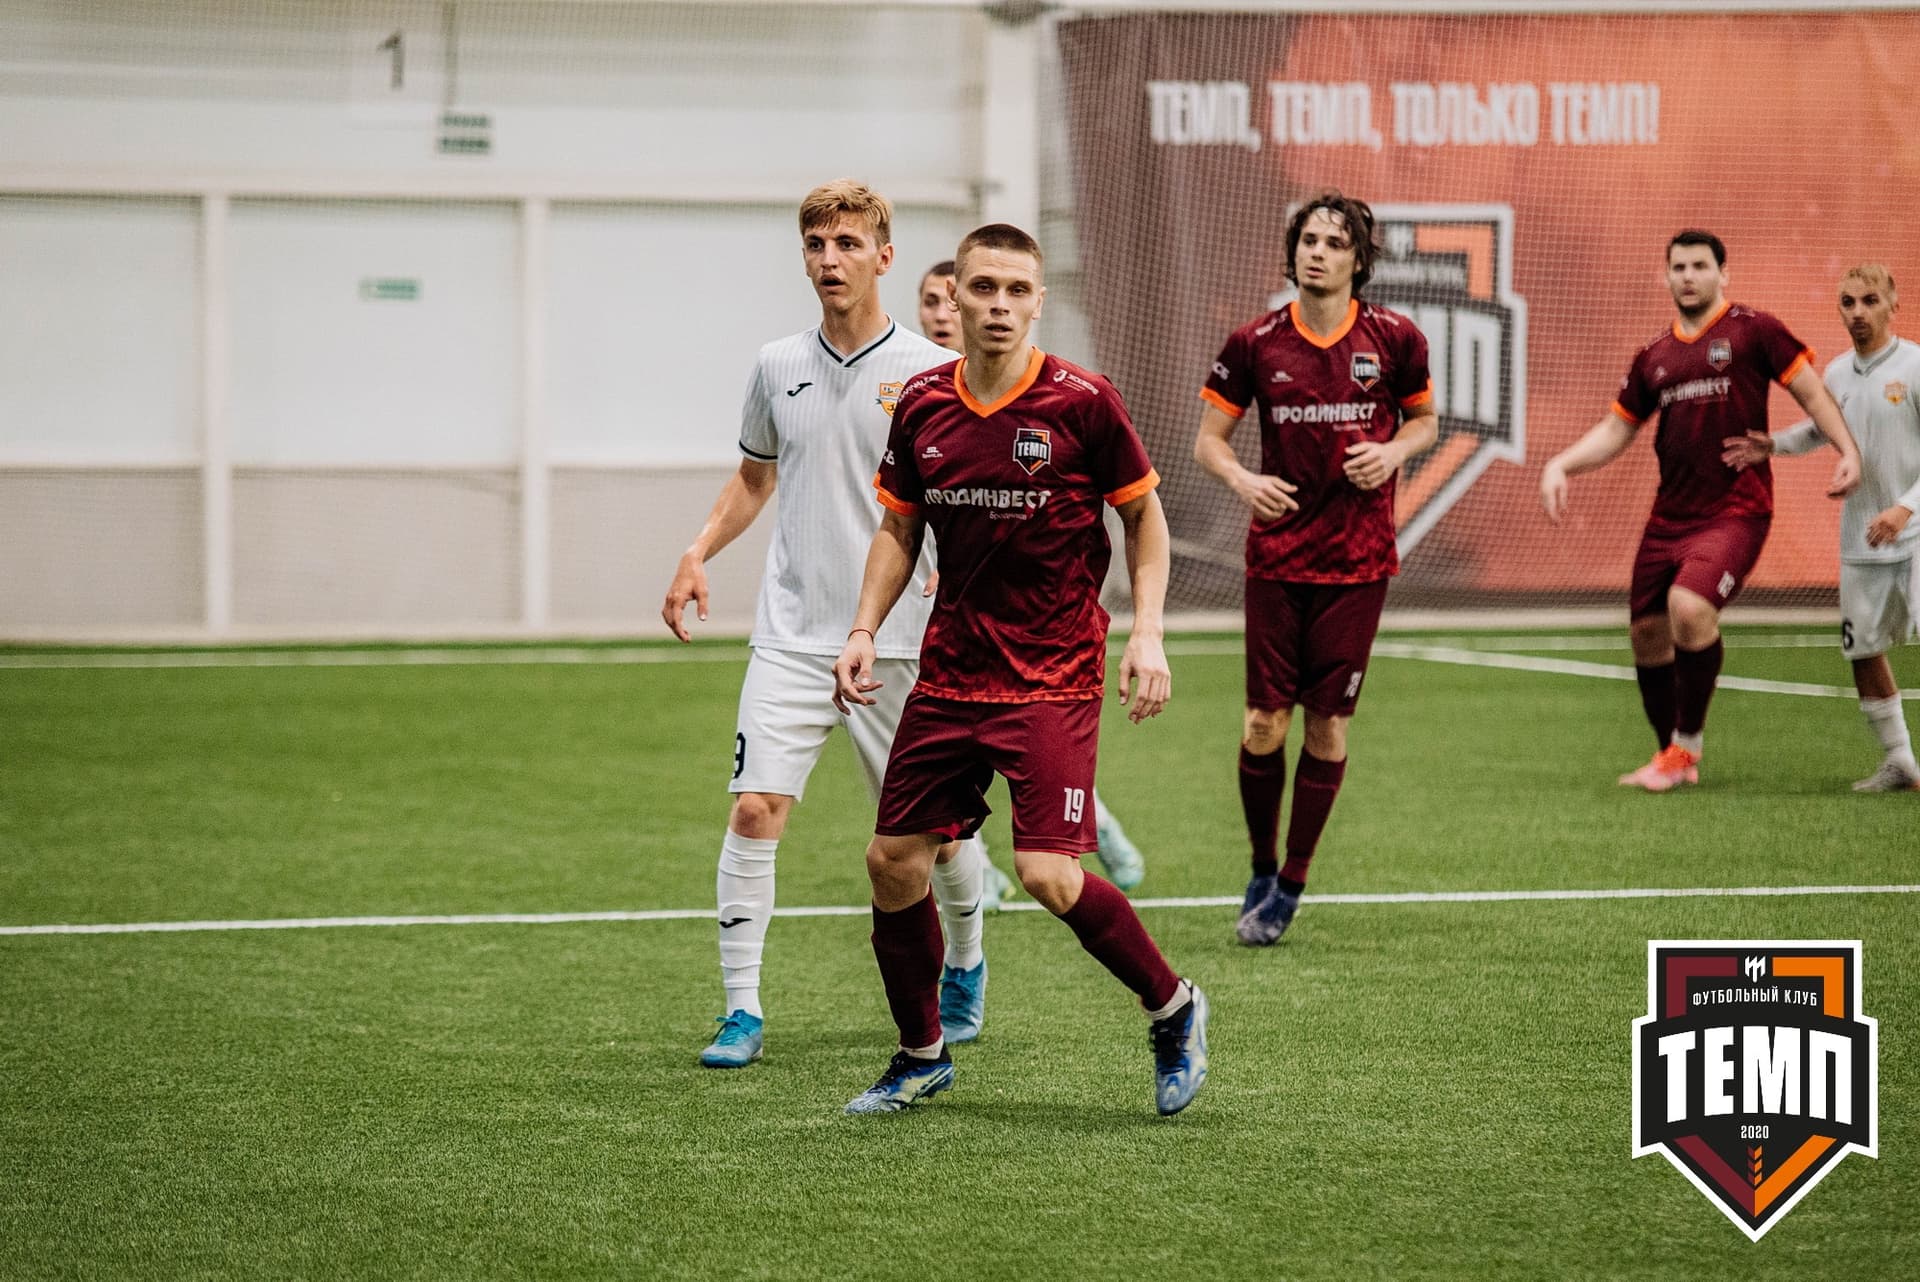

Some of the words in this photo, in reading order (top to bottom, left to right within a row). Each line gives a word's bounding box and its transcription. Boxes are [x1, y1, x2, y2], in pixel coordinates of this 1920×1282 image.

[376, 32, 403, 89] 1
[1148, 81, 1262, 152] ТЕМП,
[1268, 81, 1383, 152] ТЕМП,
[1390, 82, 1539, 146] ТОЛЬКО
[1548, 82, 1660, 144] ТЕМП!
[1017, 441, 1048, 460] ТЕМП
[1063, 786, 1085, 824] 19
